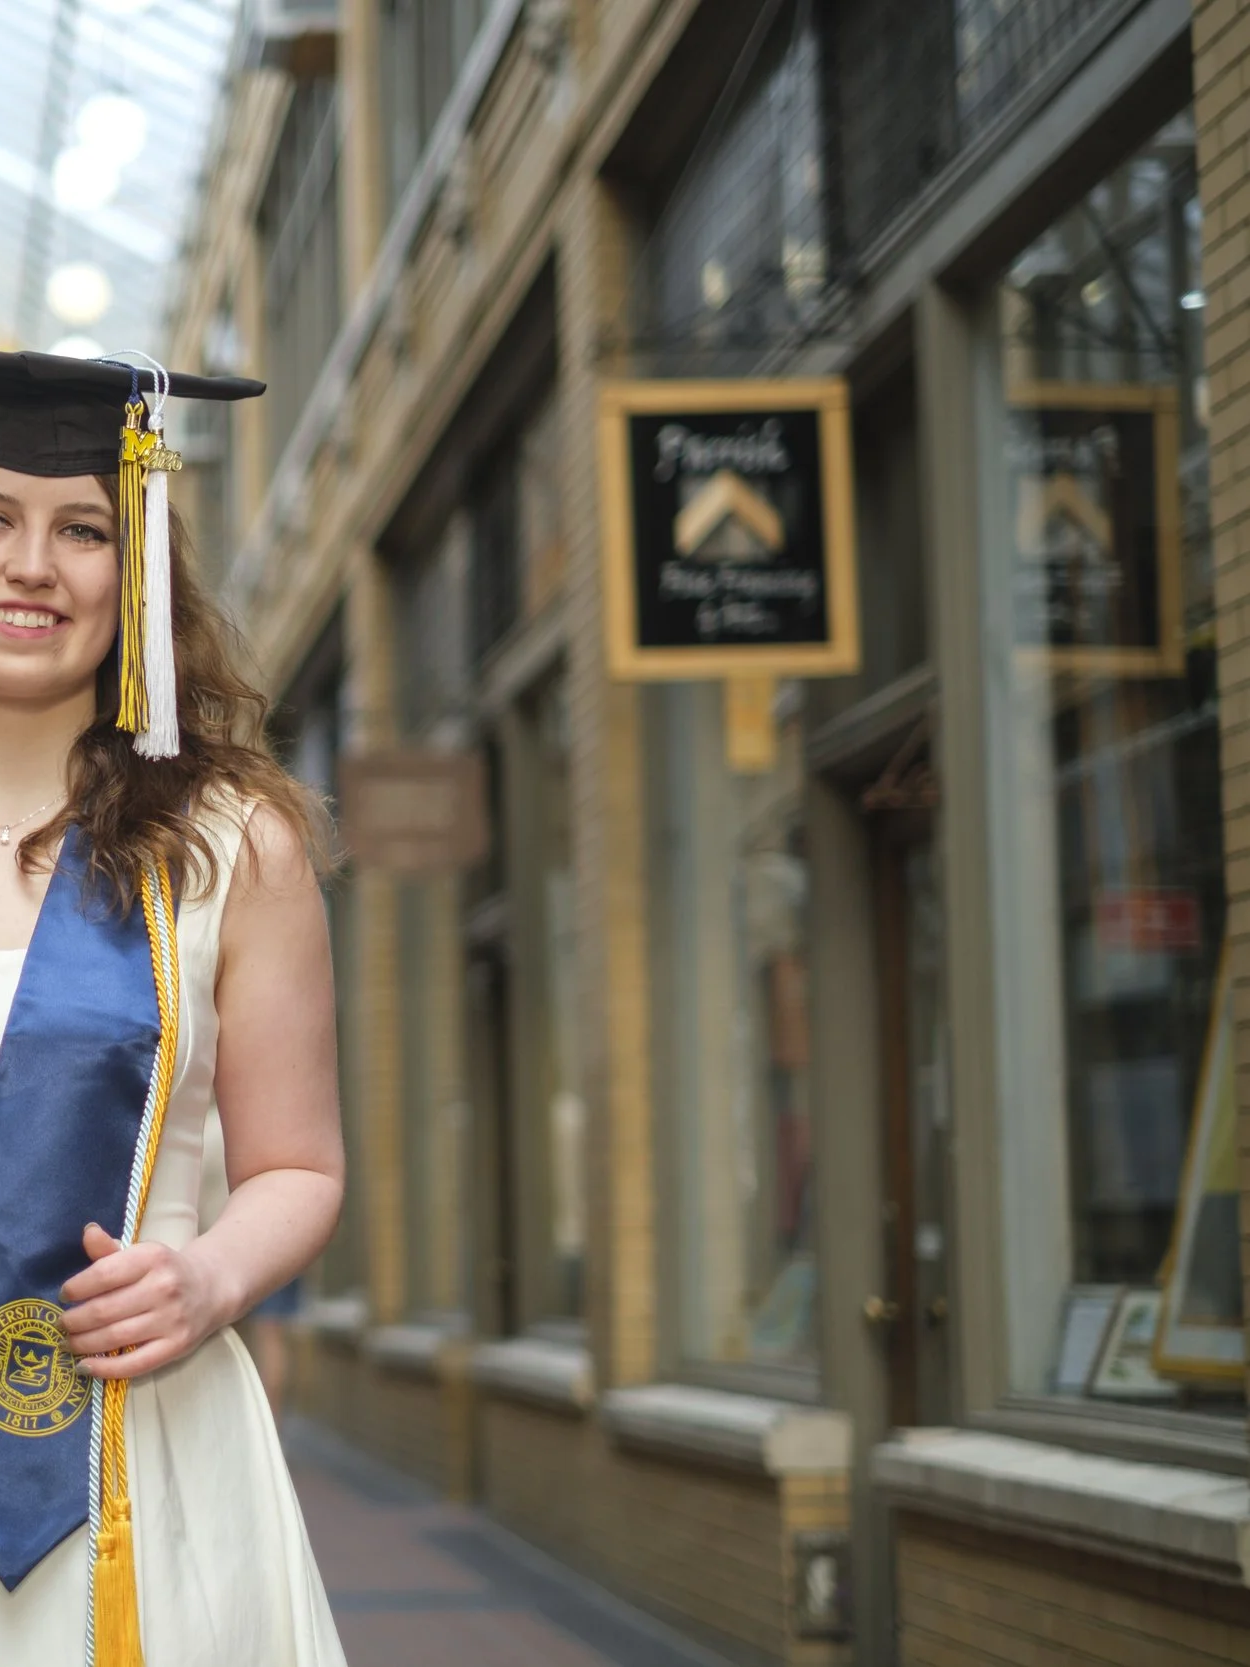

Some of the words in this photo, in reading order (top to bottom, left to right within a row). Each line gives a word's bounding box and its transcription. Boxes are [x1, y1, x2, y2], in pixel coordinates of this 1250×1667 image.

[119, 426, 157, 462] M
[145, 448, 183, 472] 2026
[45, 1311, 59, 1324] O
[5, 1412, 39, 1429] 1817
